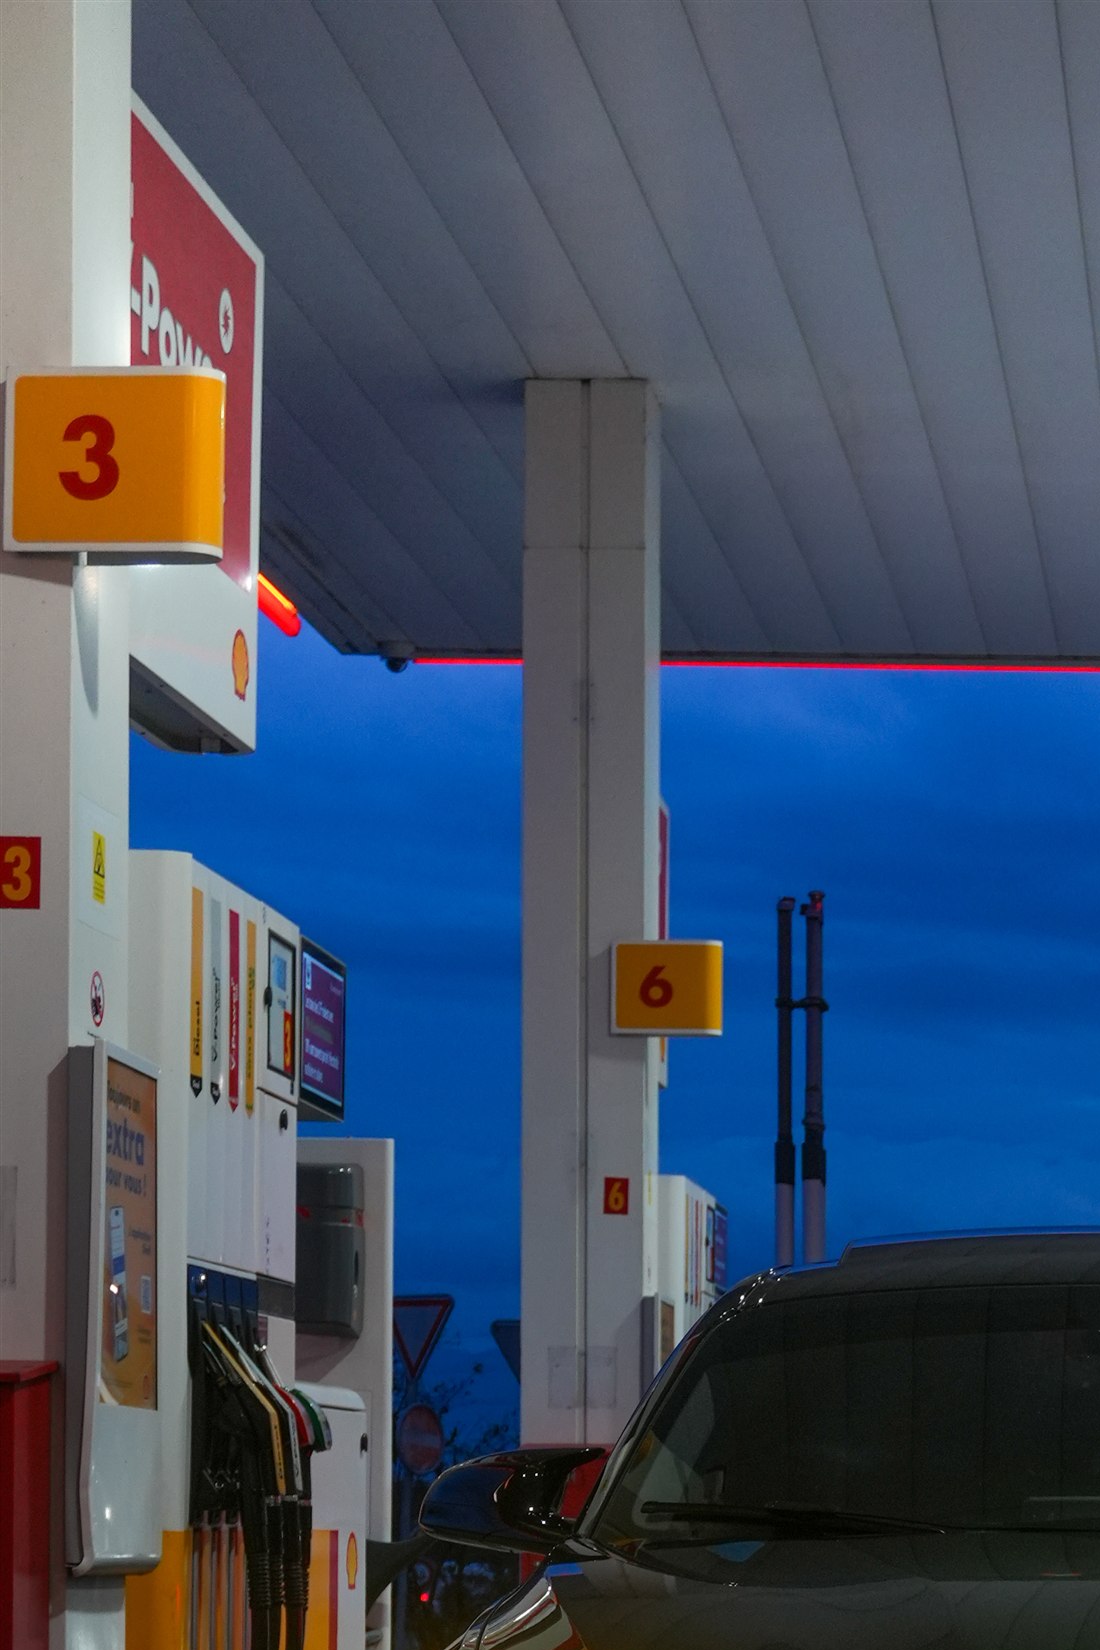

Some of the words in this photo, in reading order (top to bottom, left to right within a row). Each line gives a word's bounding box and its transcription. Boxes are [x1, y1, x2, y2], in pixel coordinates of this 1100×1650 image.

[58, 414, 119, 500] 3
[2, 846, 32, 901] 3
[639, 965, 673, 1008] 6
[106, 1117, 144, 1166] extra
[608, 1182, 625, 1212] 6
